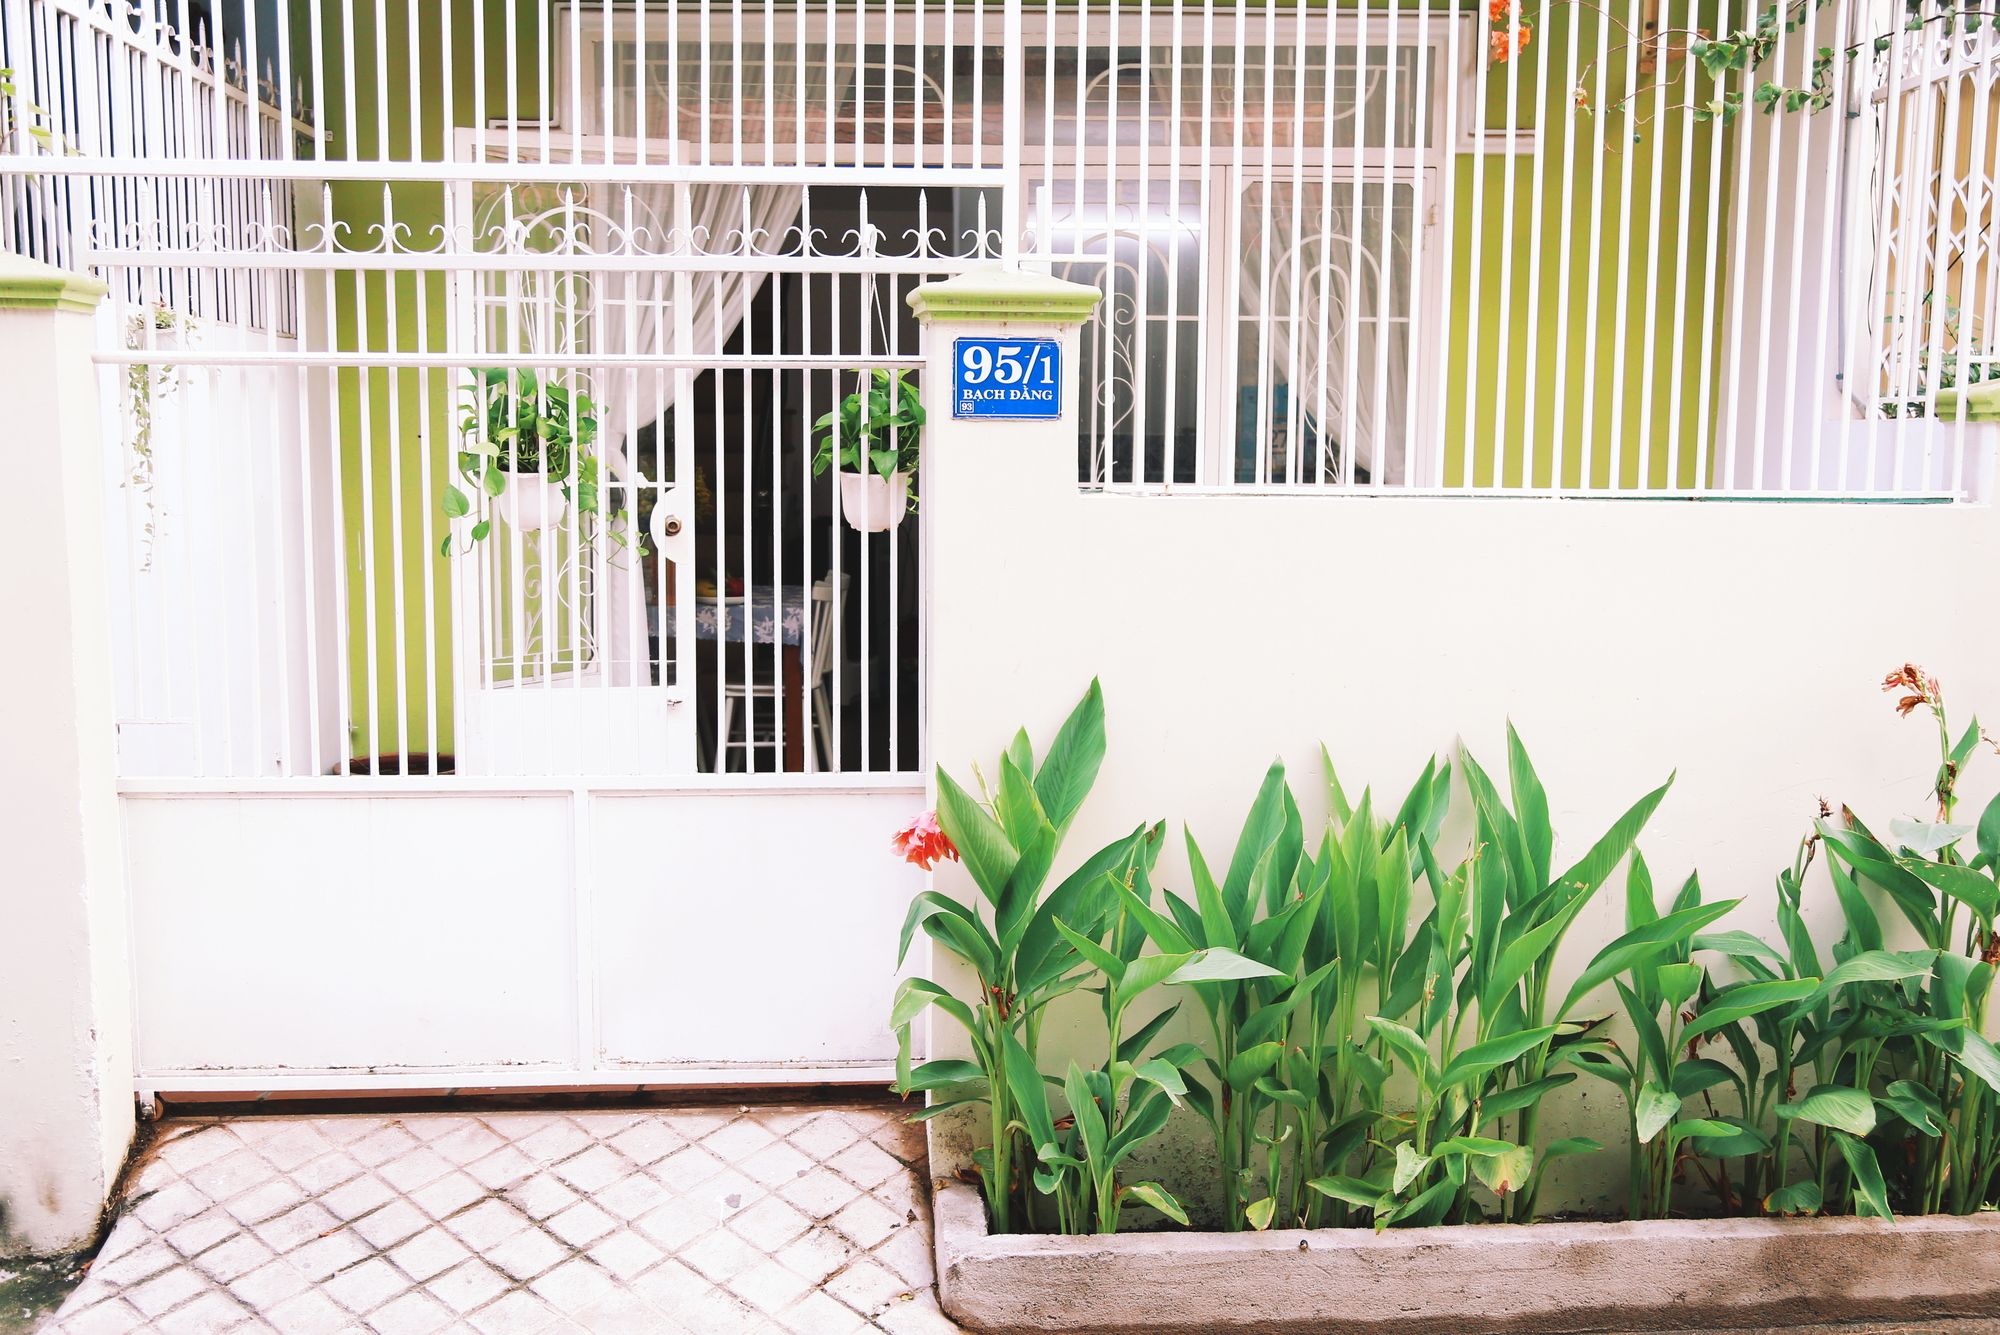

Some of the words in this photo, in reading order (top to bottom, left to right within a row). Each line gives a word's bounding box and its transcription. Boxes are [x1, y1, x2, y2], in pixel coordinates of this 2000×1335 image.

[963, 345, 1054, 384] 95/1
[963, 389, 1005, 402] BẠCH
[961, 402, 973, 411] 93
